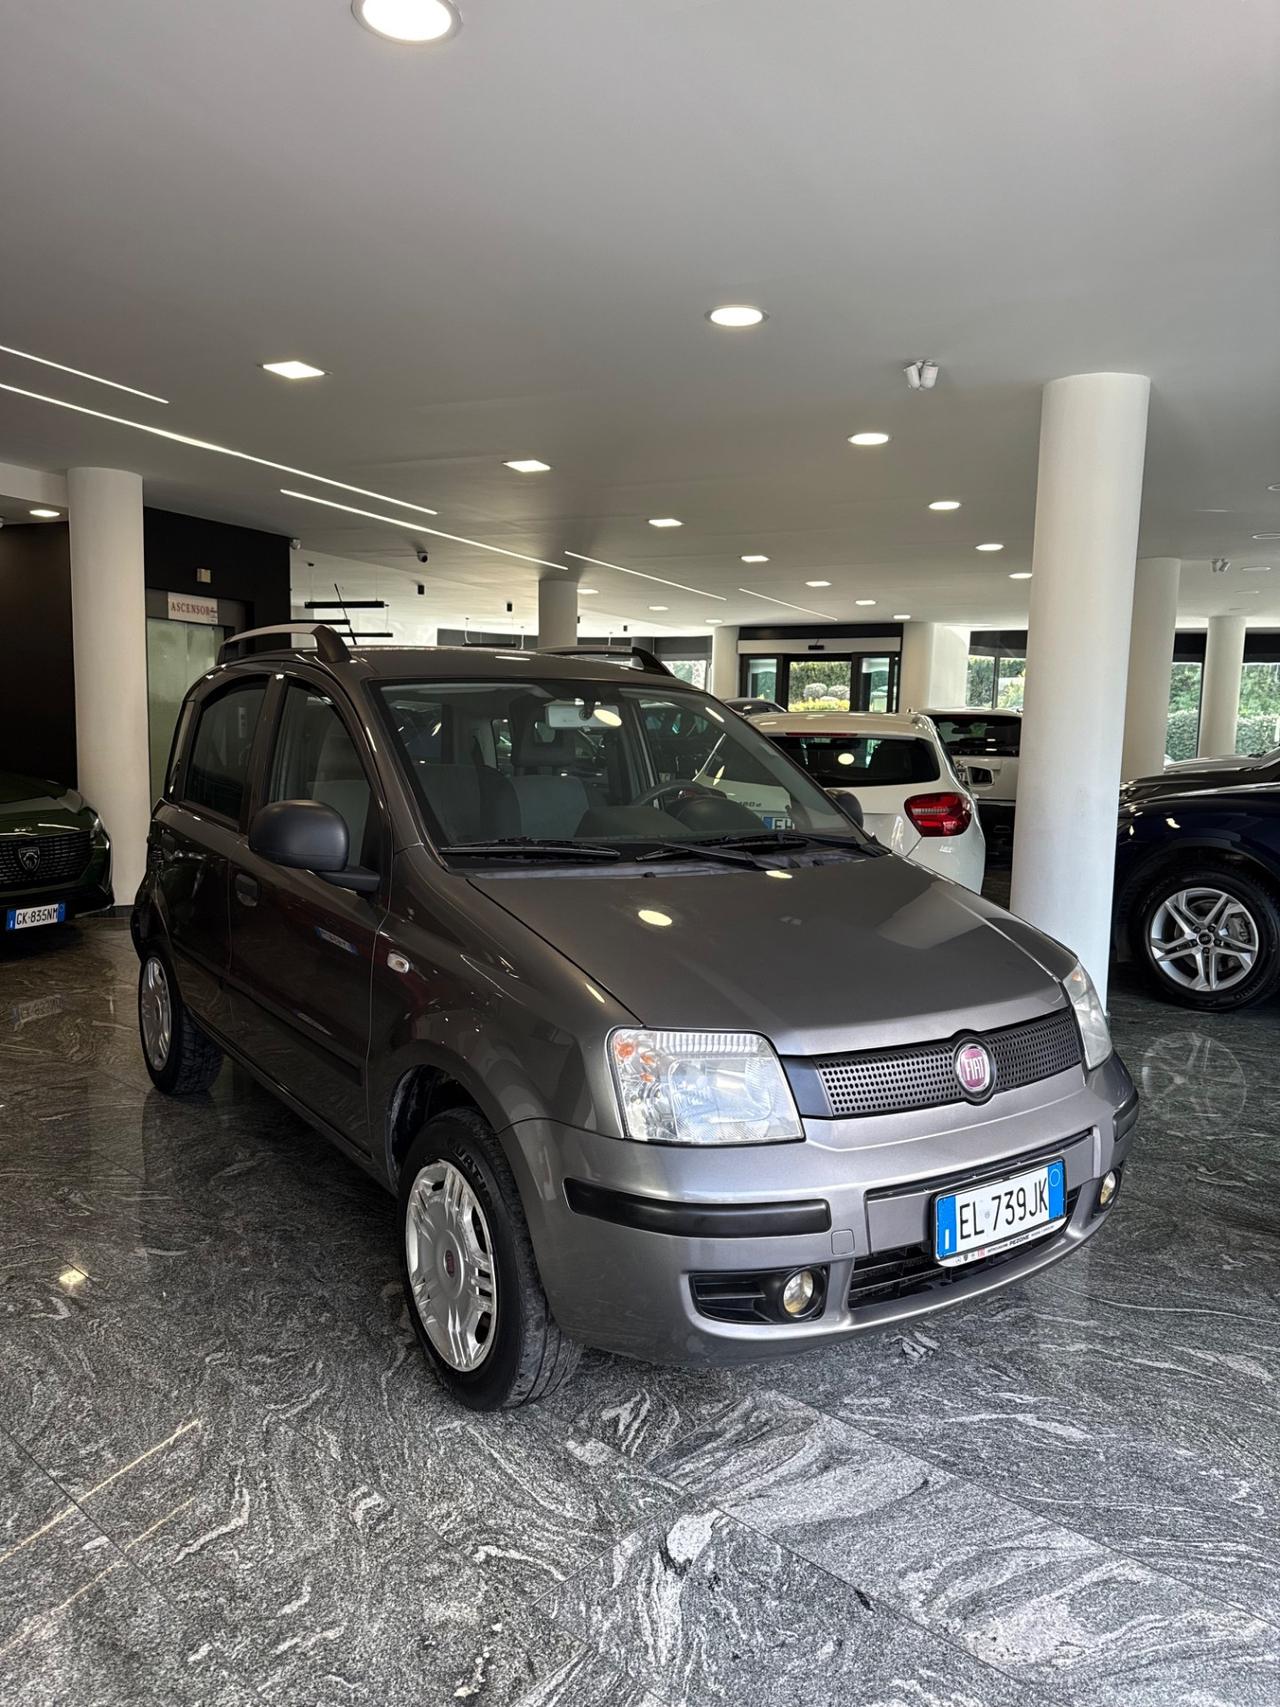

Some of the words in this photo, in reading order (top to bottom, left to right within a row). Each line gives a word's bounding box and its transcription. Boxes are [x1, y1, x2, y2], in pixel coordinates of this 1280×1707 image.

[962, 1057, 985, 1080] FIAT
[959, 1201, 985, 1240] EL
[991, 1177, 1049, 1232] 739JK
